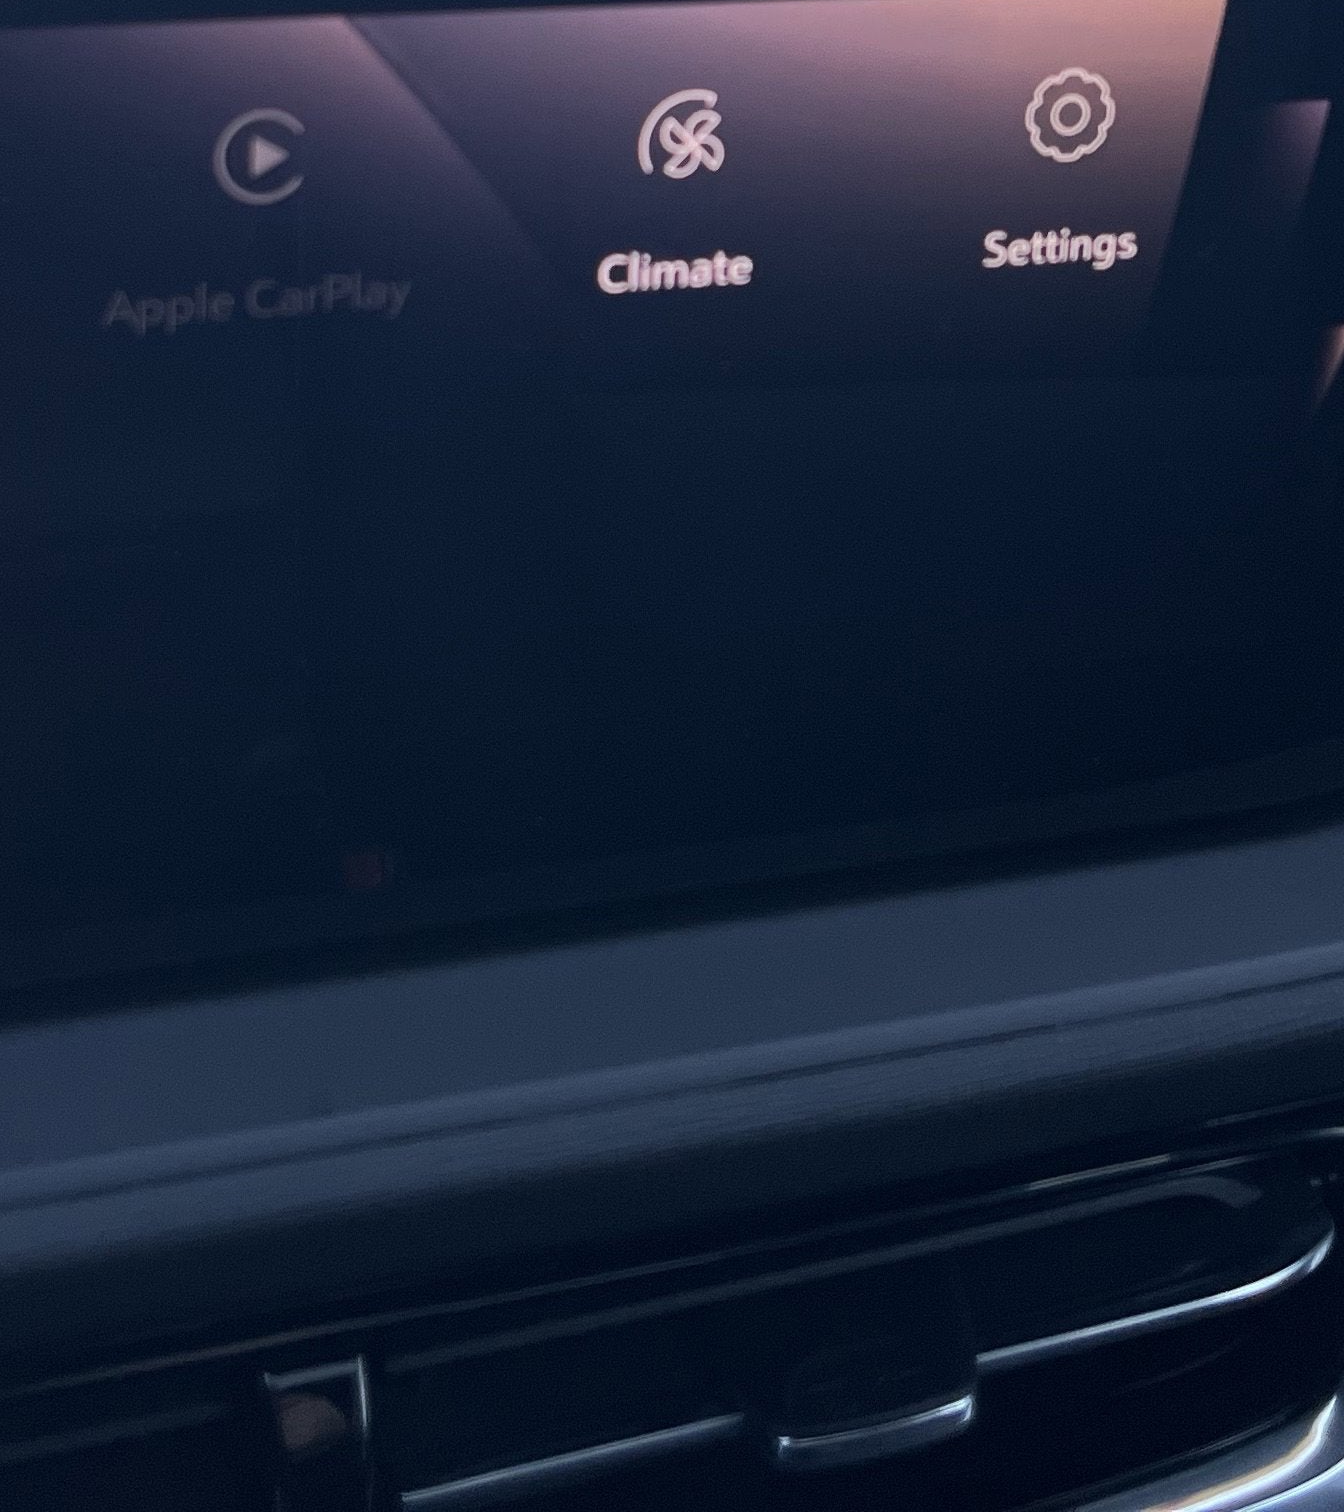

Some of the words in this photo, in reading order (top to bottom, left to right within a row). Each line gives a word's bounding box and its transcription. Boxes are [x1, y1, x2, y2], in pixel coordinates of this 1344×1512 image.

[596, 249, 754, 295] Climate
[981, 226, 1139, 272] Settings
[102, 284, 236, 335] Apple
[245, 271, 412, 320] CarPlay
